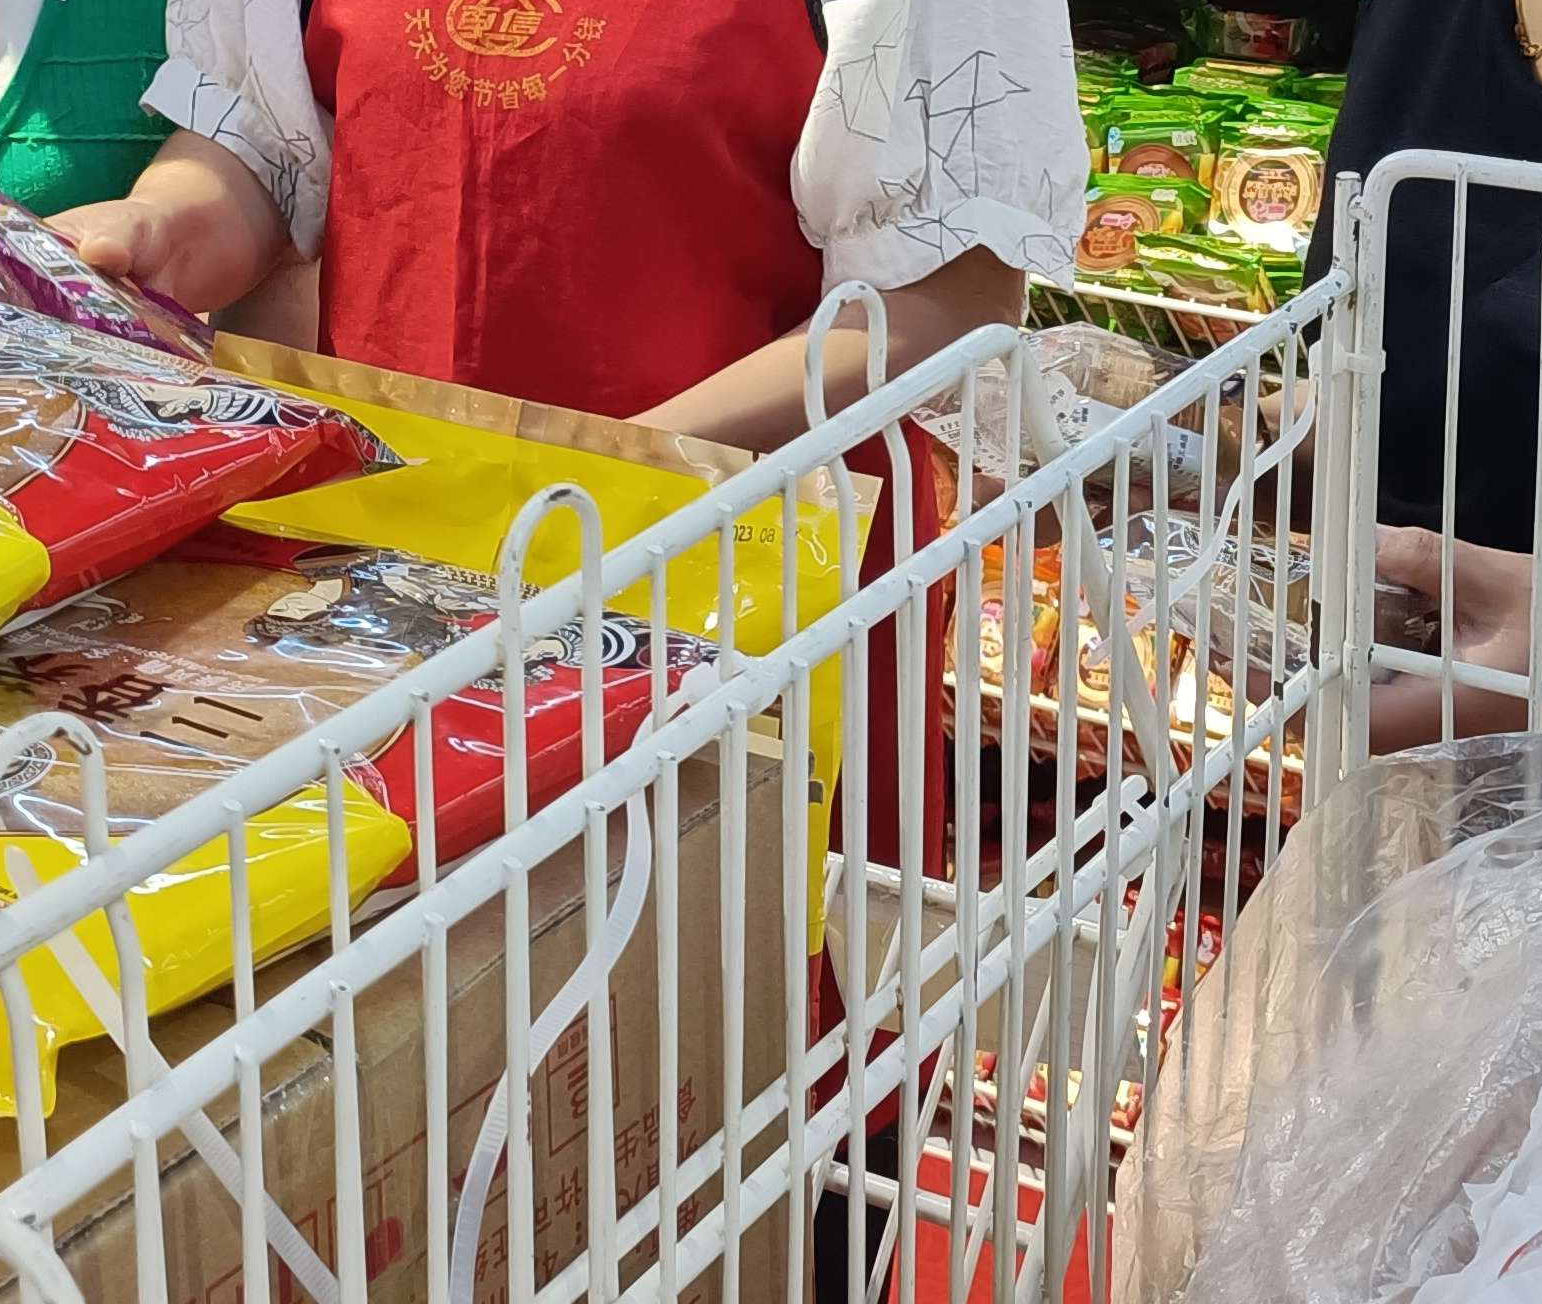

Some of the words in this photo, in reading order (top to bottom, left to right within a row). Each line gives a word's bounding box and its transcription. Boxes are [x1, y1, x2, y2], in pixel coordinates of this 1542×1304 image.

[404, 7, 607, 110] 天天为您节省每一分钱
